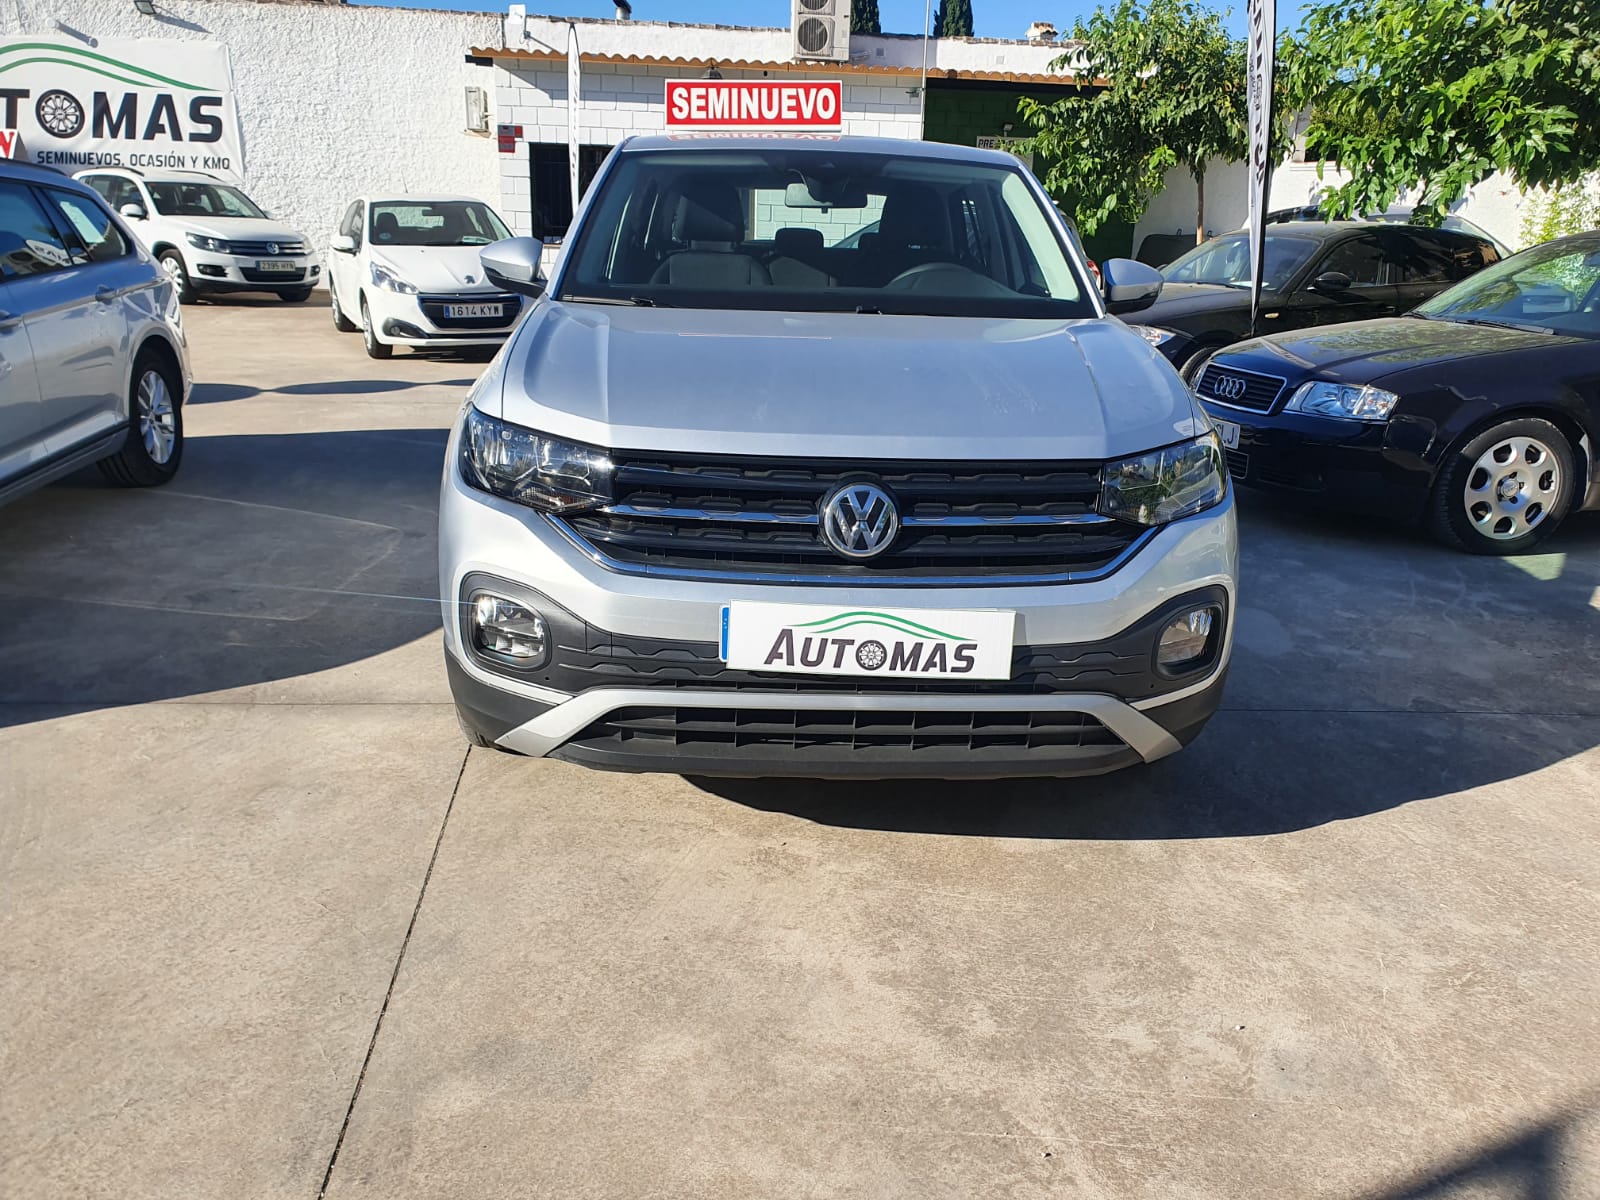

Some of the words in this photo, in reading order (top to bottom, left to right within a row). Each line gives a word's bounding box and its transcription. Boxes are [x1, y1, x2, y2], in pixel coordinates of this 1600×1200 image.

[671, 87, 836, 120] SEMINUEVO
[37, 150, 125, 167] SEMINUEVOS,
[129, 151, 185, 168] OCASIÓN
[190, 156, 198, 168] Y
[451, 306, 477, 316] 1614
